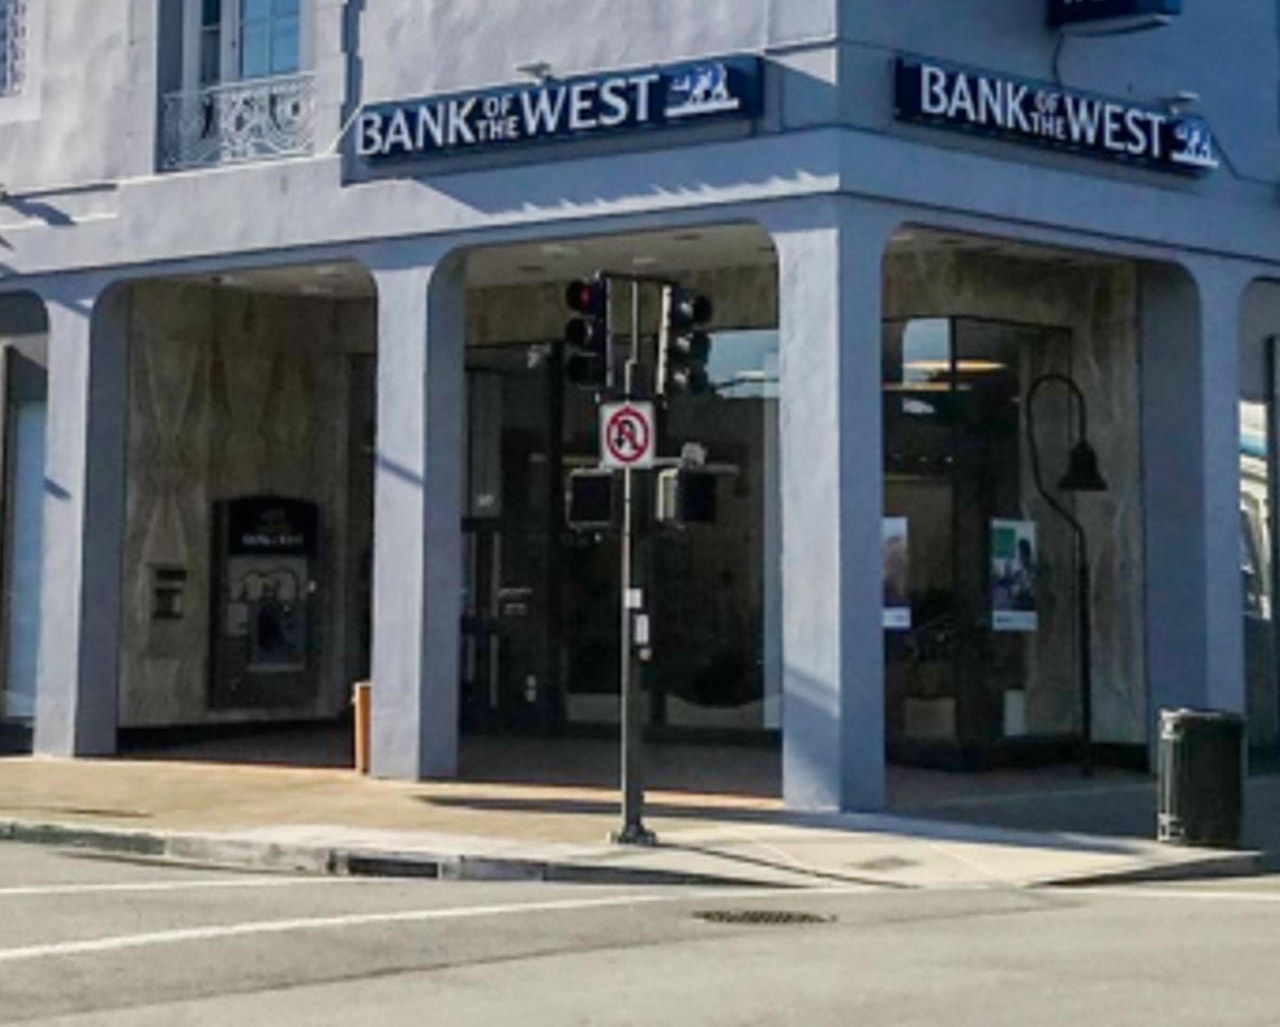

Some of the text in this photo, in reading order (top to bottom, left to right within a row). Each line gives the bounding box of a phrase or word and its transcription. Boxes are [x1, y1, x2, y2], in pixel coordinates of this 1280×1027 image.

[355, 73, 660, 156] BANK OF THE WEST
[921, 63, 1167, 158] BANK OF THE WEST
